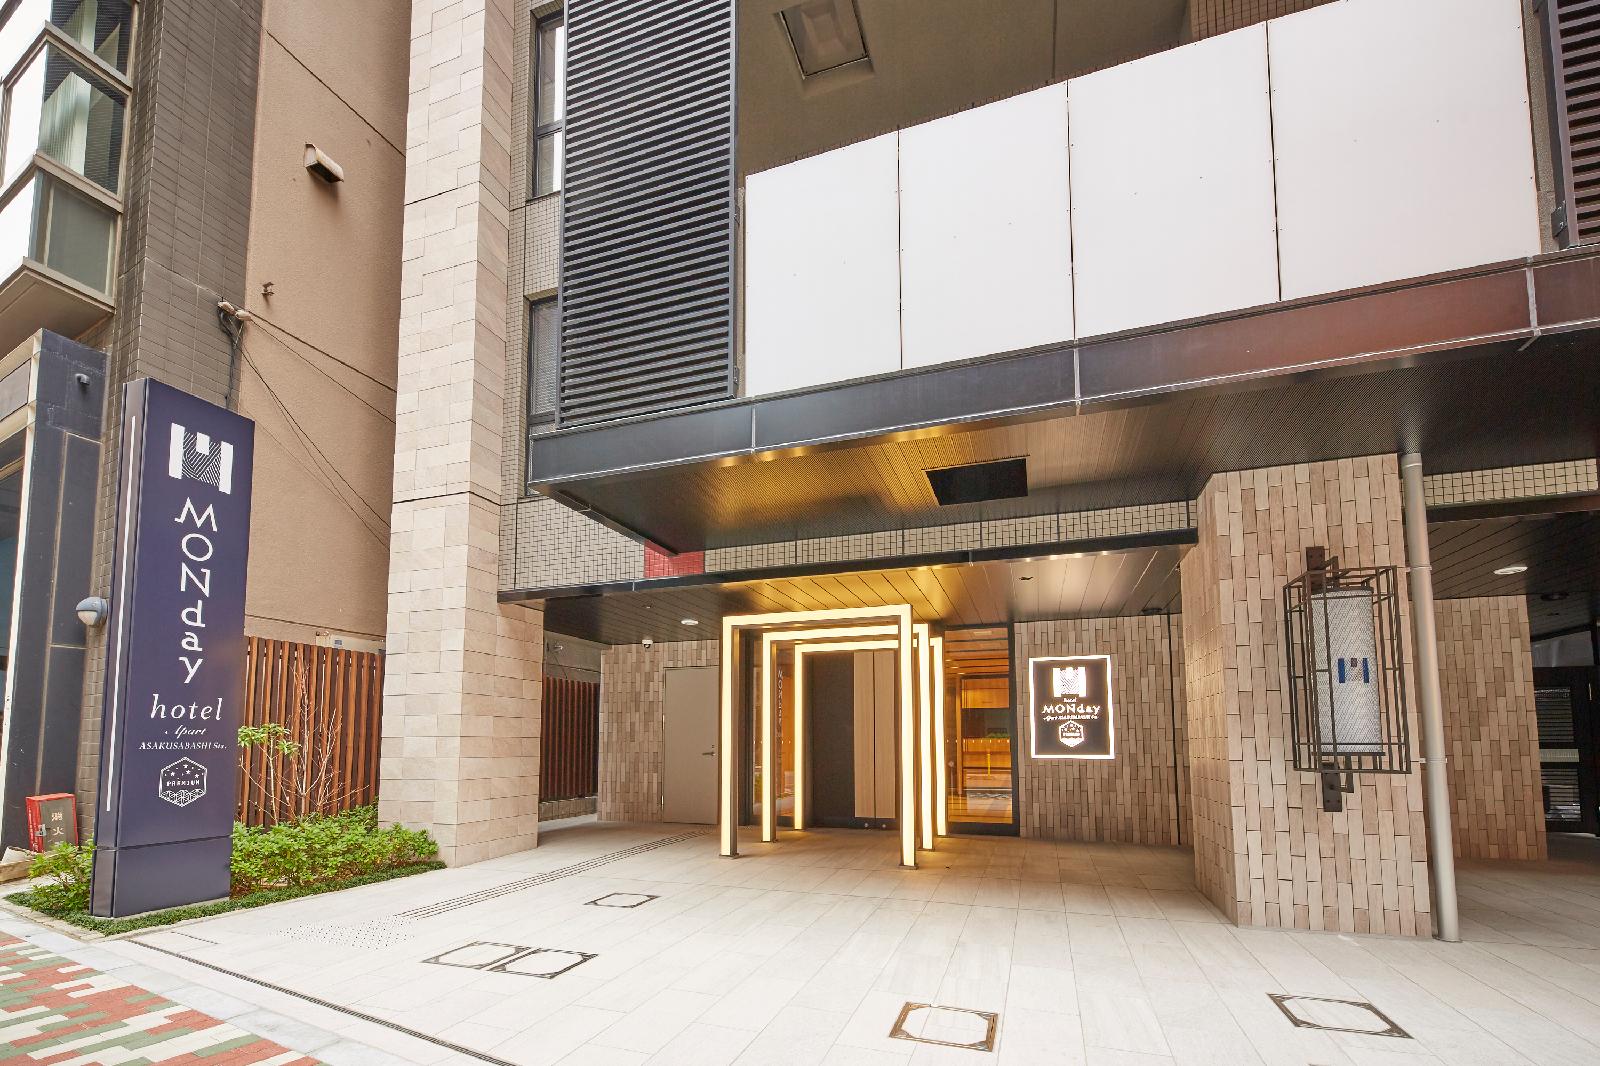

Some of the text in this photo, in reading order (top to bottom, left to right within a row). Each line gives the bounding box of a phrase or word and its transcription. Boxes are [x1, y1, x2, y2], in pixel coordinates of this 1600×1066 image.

[174, 497, 218, 684] MONday
[150, 693, 223, 721] hotel
[1041, 703, 1101, 716] MONday
[139, 741, 212, 750] ASAKUSABASHI
[51, 811, 65, 847] 消火
